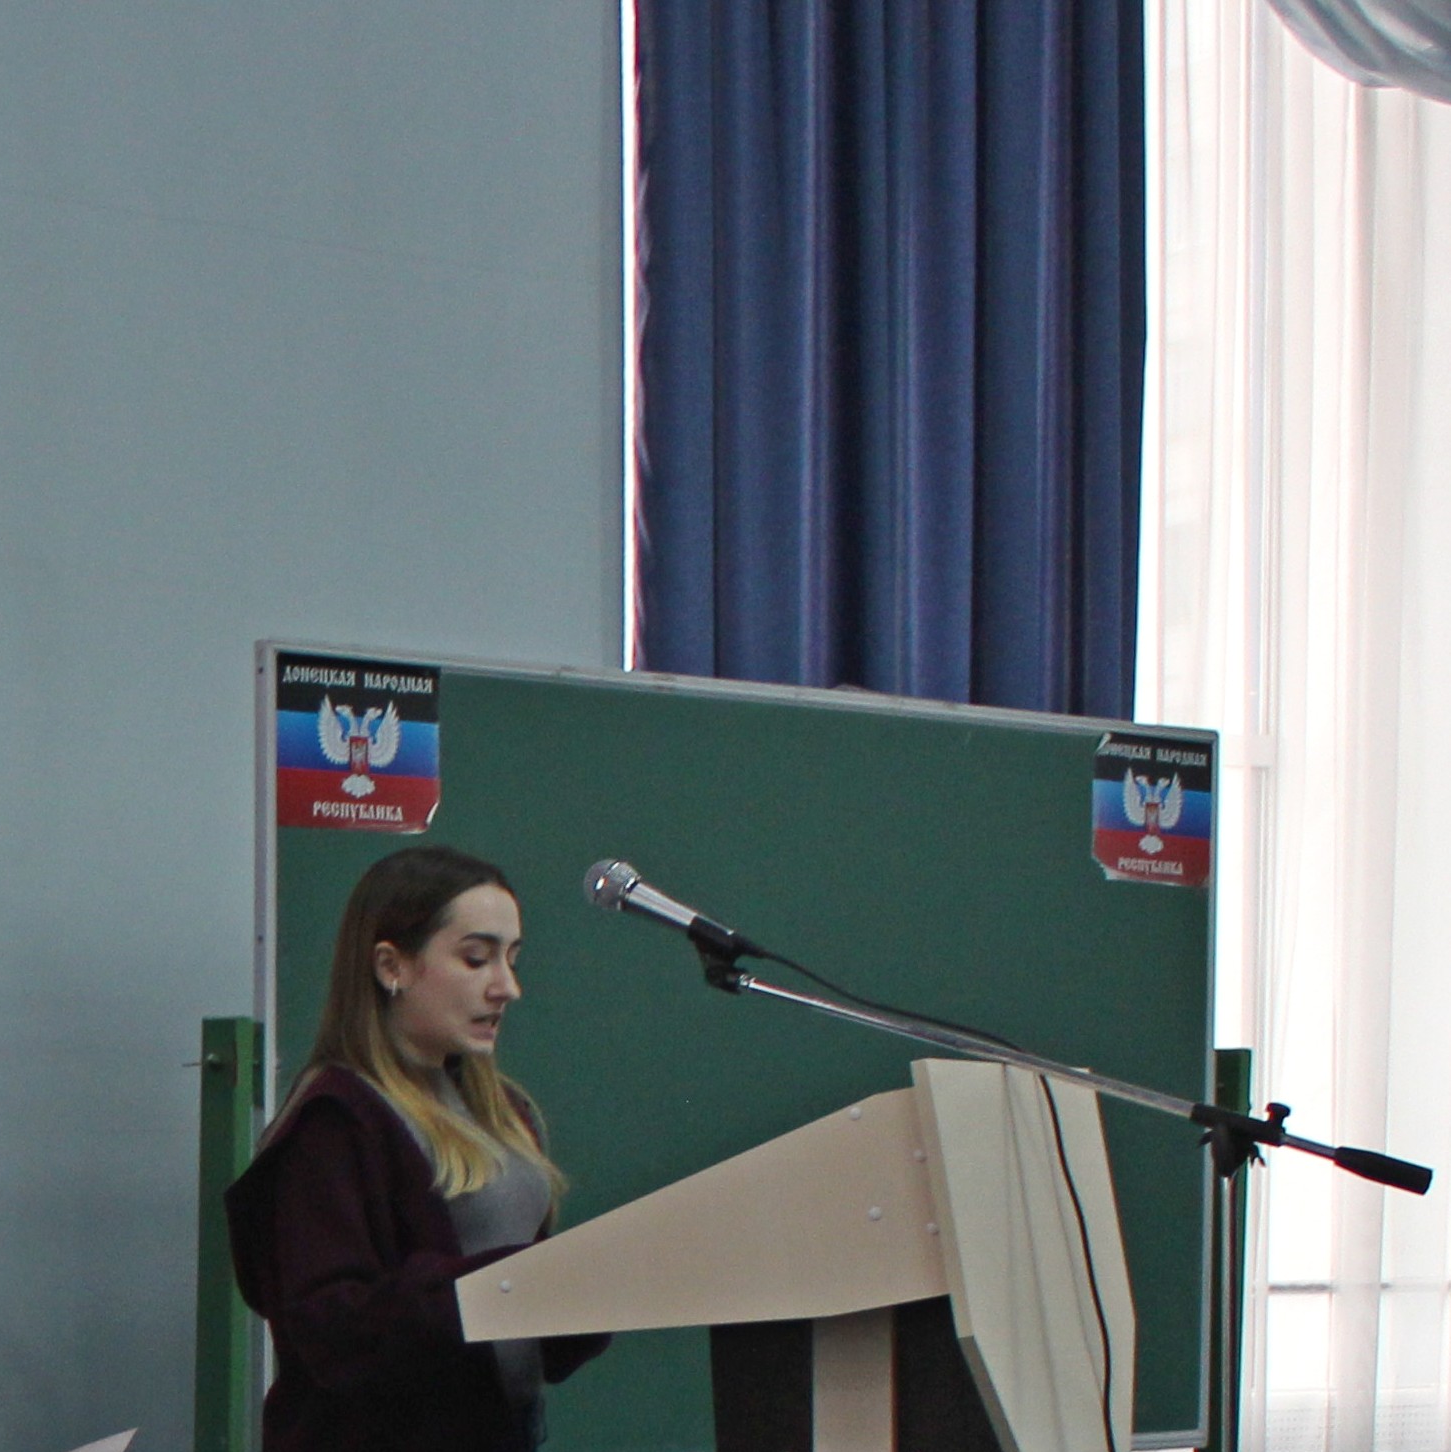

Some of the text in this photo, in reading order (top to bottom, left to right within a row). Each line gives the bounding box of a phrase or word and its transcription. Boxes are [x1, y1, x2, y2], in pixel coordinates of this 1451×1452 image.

[283, 665, 432, 693] ДОНЕЦКАЯ НАРОДНАЯ
[313, 801, 402, 822] РЕСПУБЛИКА
